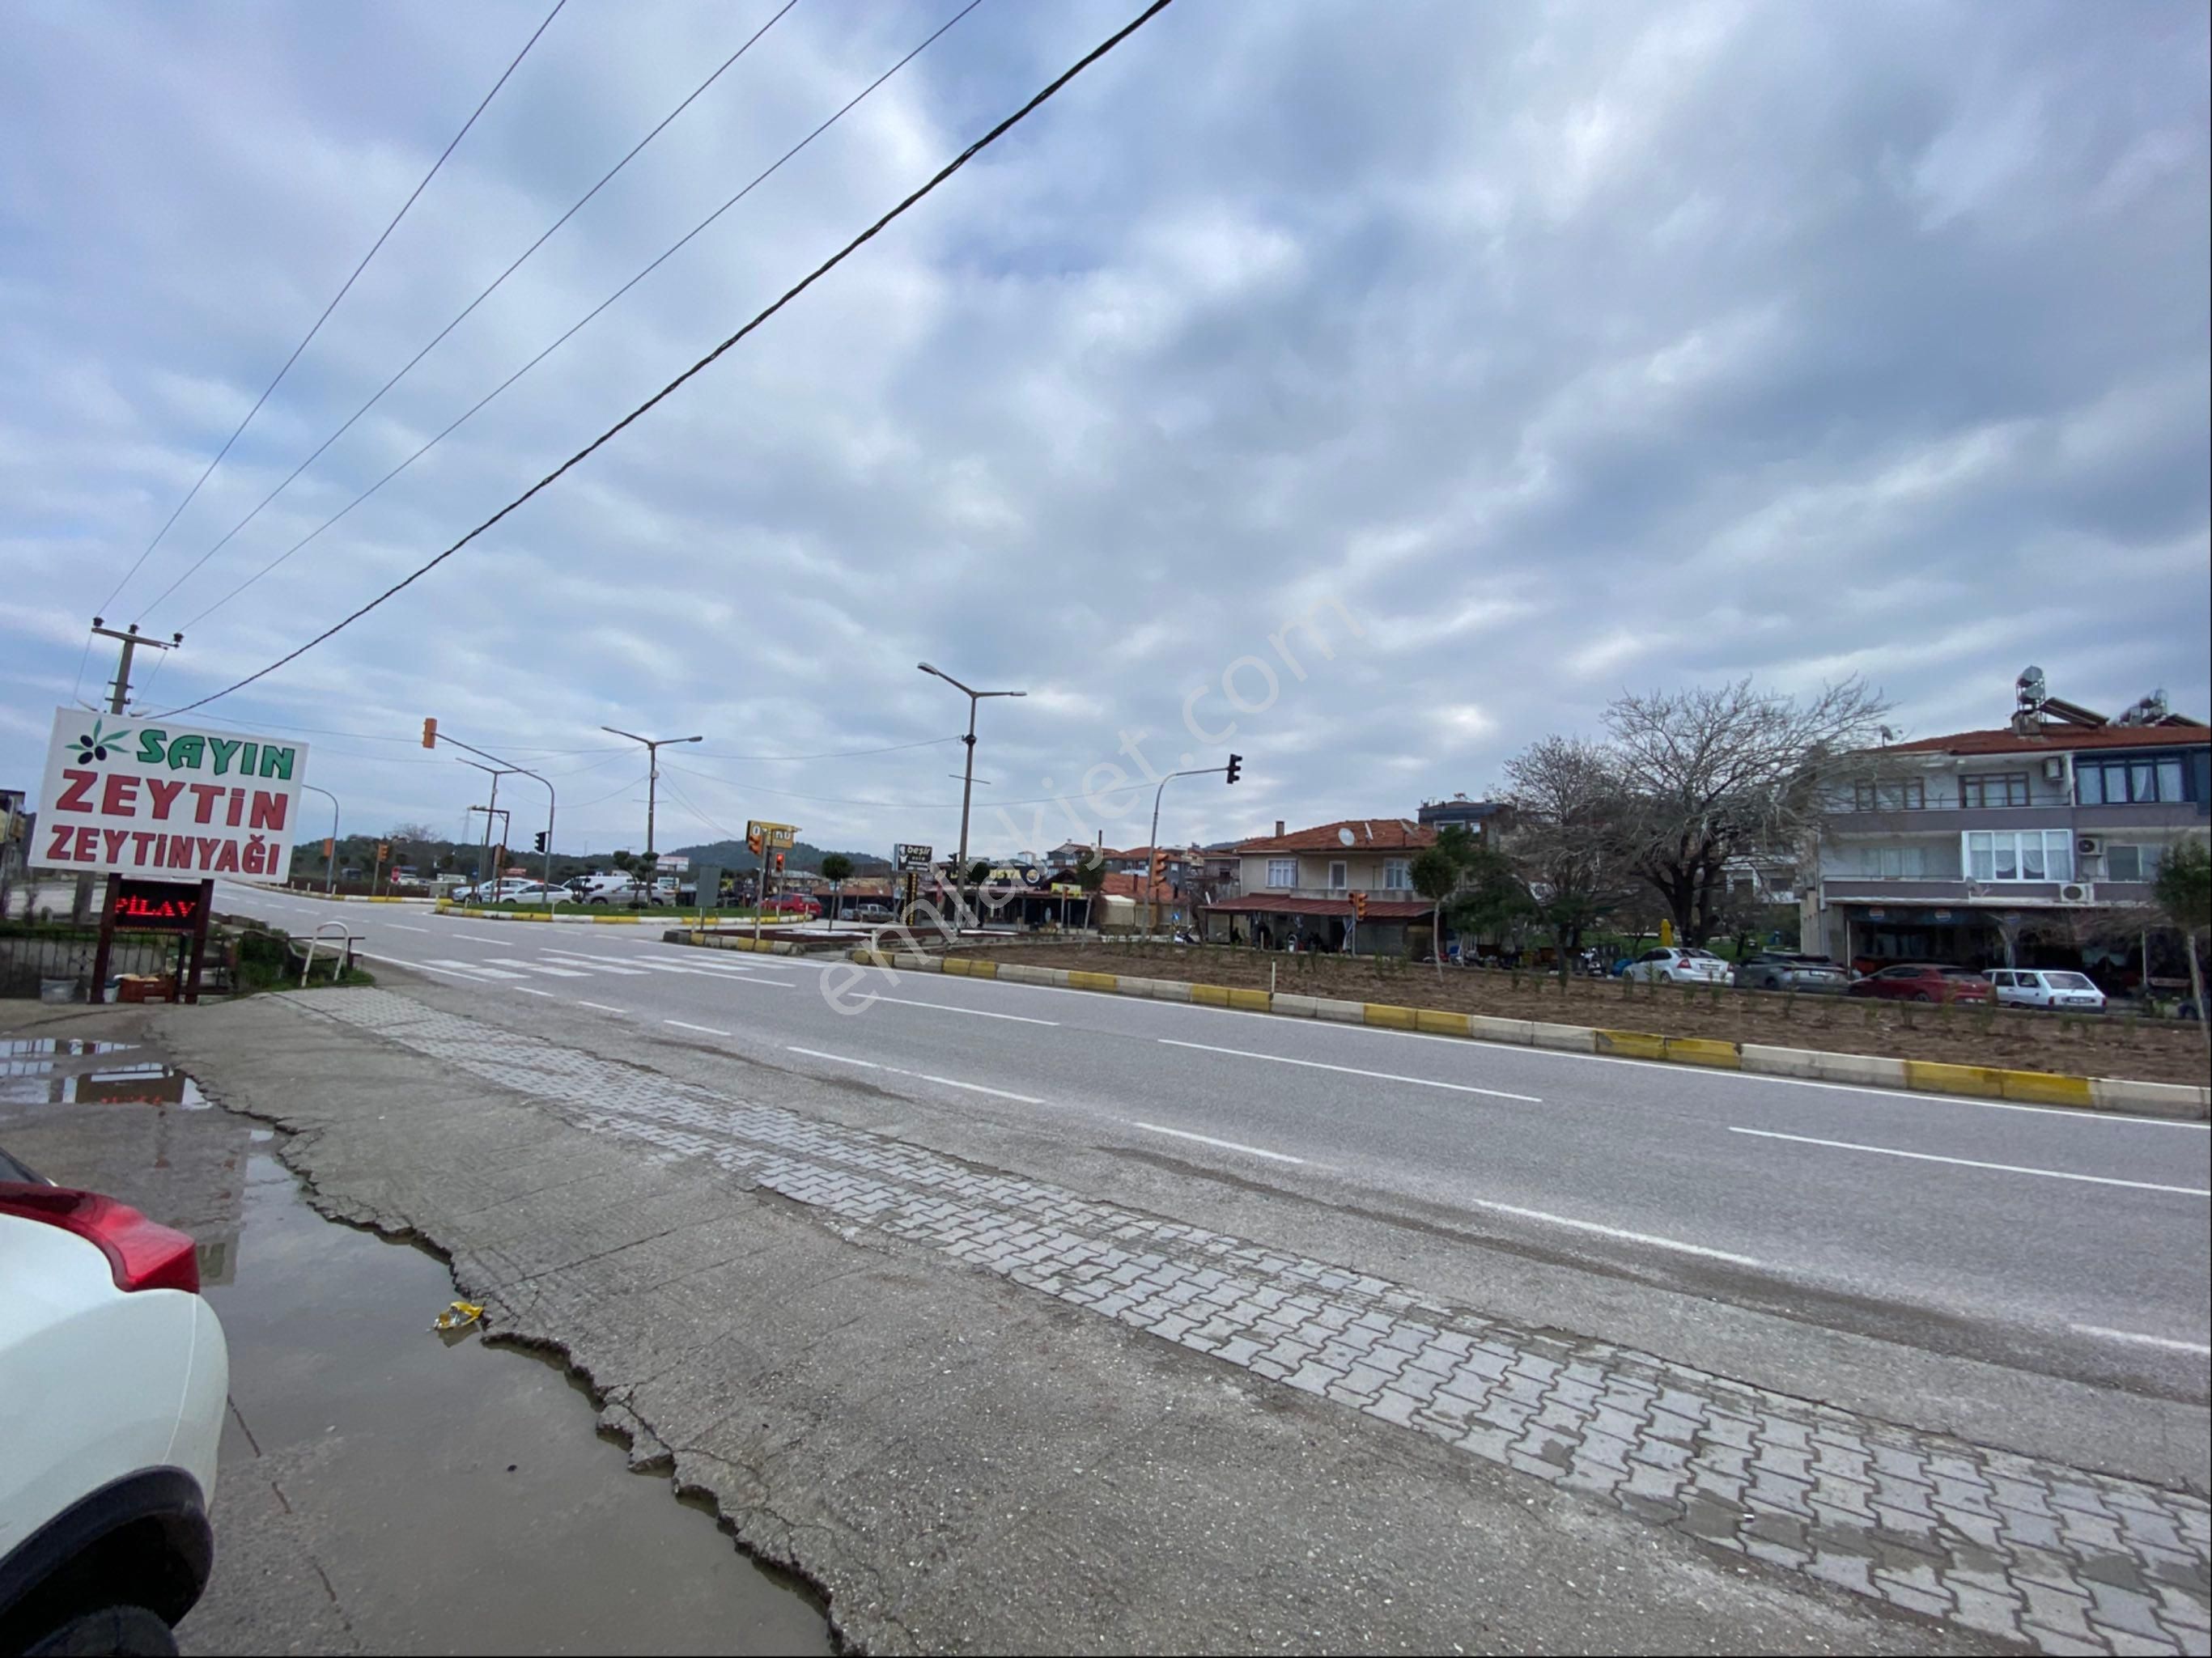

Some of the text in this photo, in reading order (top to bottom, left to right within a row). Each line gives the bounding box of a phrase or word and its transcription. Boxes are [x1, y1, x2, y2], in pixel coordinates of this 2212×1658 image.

[137, 729, 295, 780] SAYIN
[56, 769, 288, 831] ZEYTİN
[46, 825, 280, 876] ZEYTİNYAĞI
